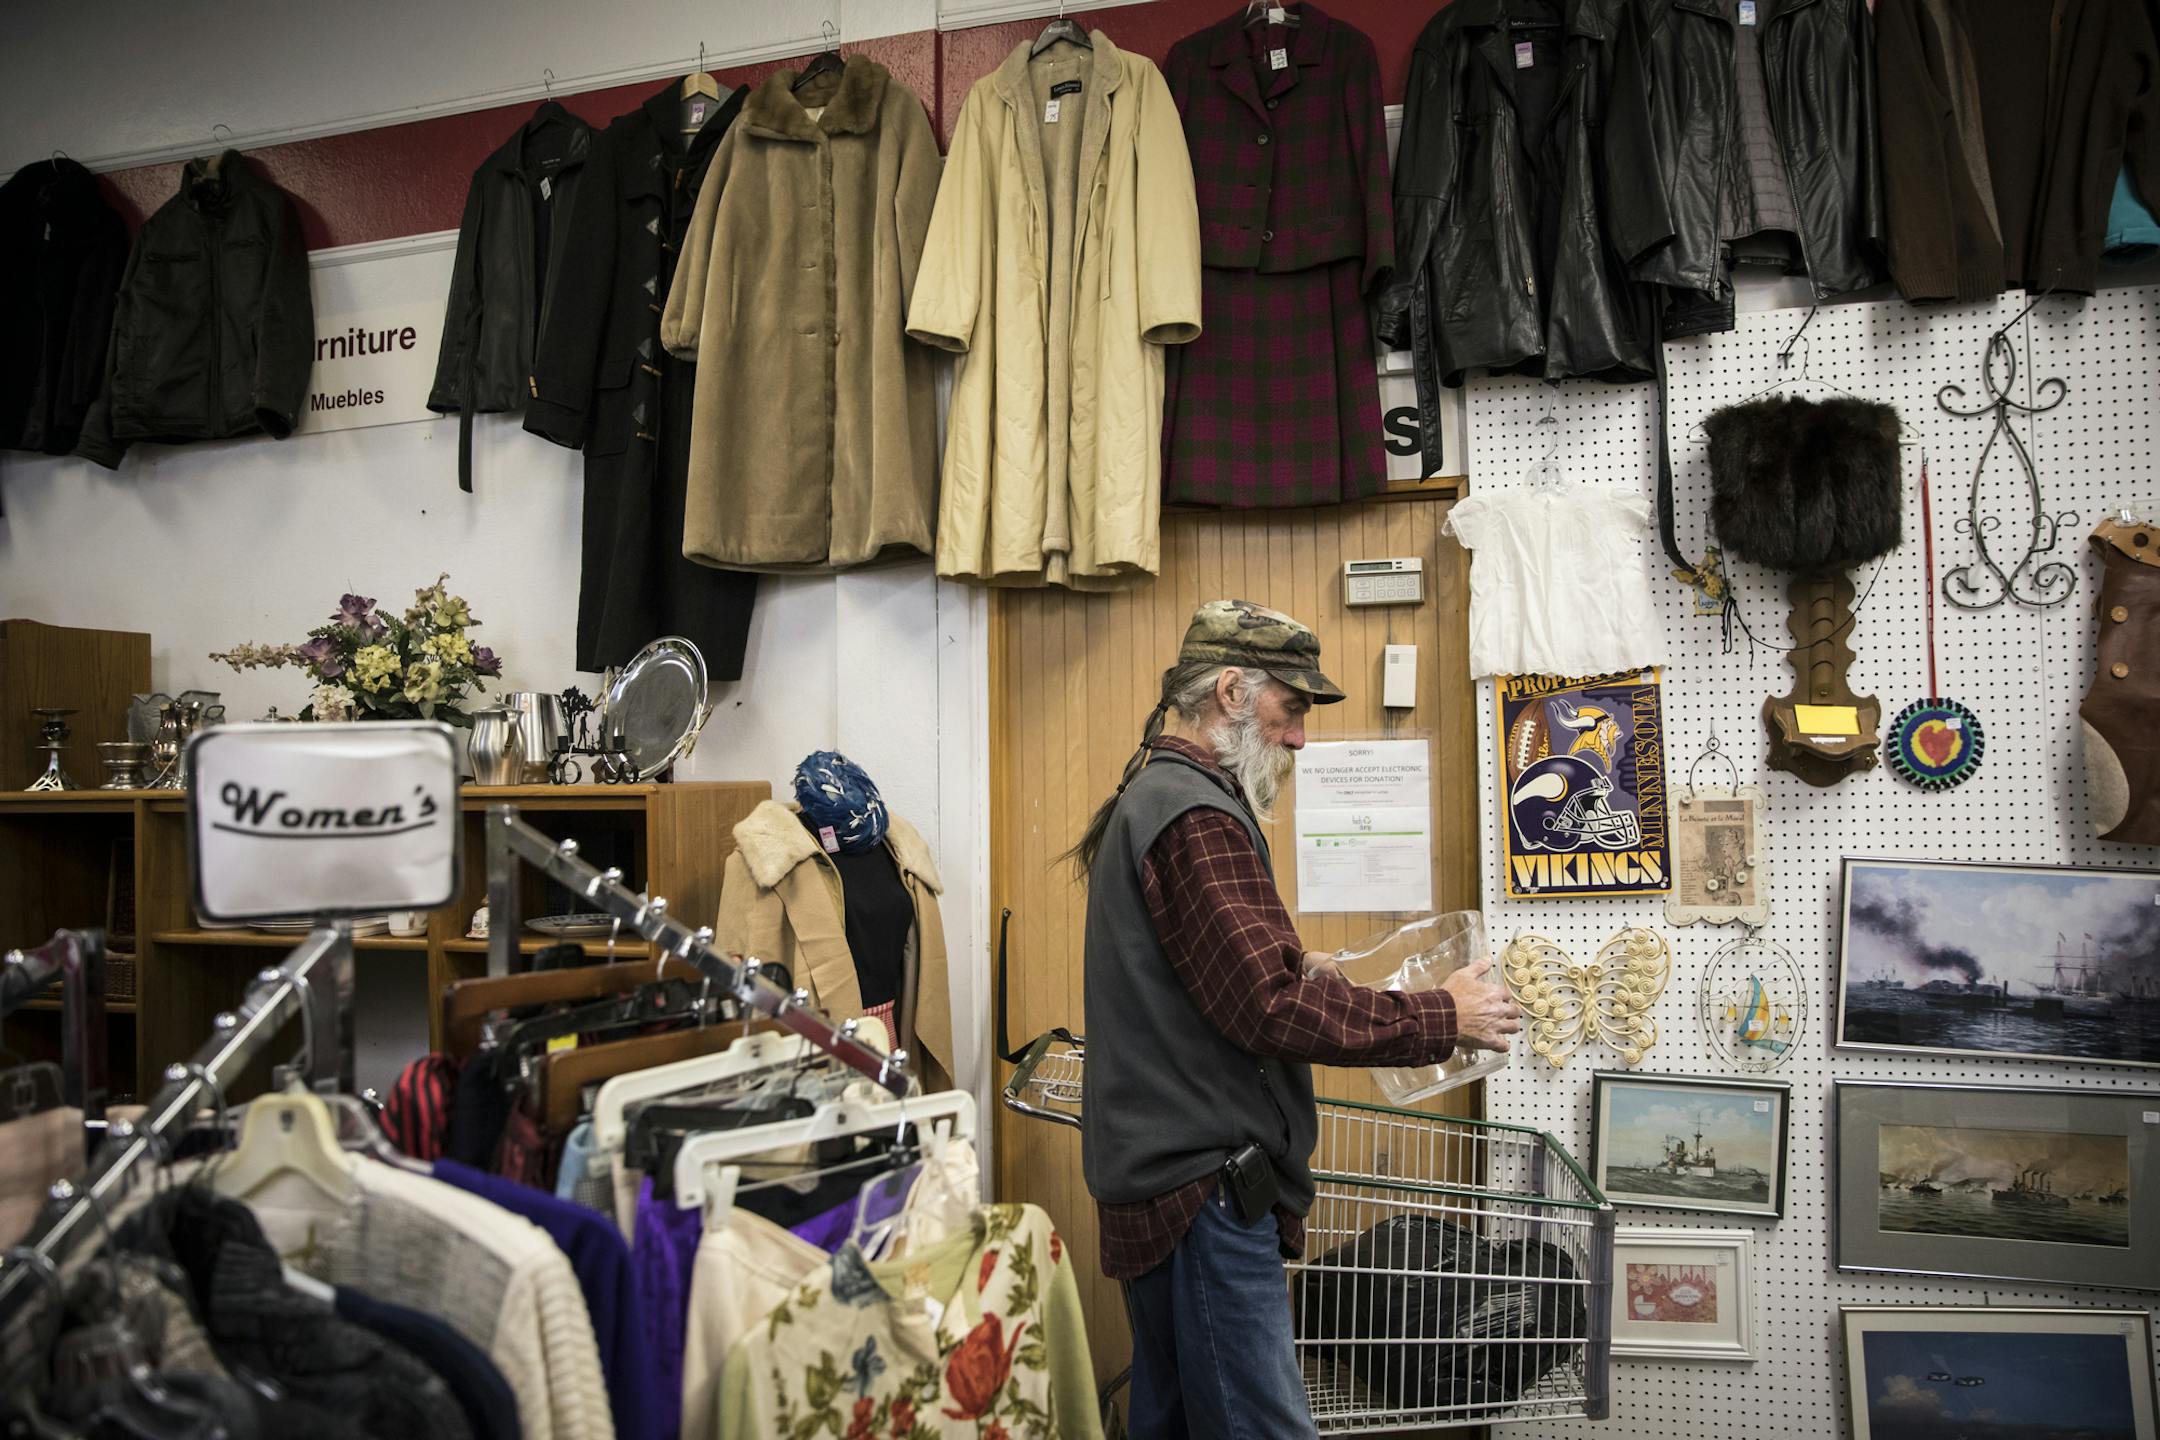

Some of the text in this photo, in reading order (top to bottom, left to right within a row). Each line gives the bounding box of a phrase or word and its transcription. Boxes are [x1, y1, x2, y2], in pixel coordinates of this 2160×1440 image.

[313, 326, 417, 362] rniture
[311, 388, 384, 412] Muebles
[1348, 749, 1374, 757] SORRY!
[1631, 685, 1665, 849] MINNESOTA
[1302, 767, 1313, 775] WE
[1326, 766, 1354, 774] LONGER
[1355, 765, 1380, 773] ACCEPT
[1381, 764, 1423, 773] ELECTRONIC
[1320, 776, 1349, 784] DEVICES
[220, 780, 438, 829] Women's
[1510, 850, 1664, 888] VIKINGS
